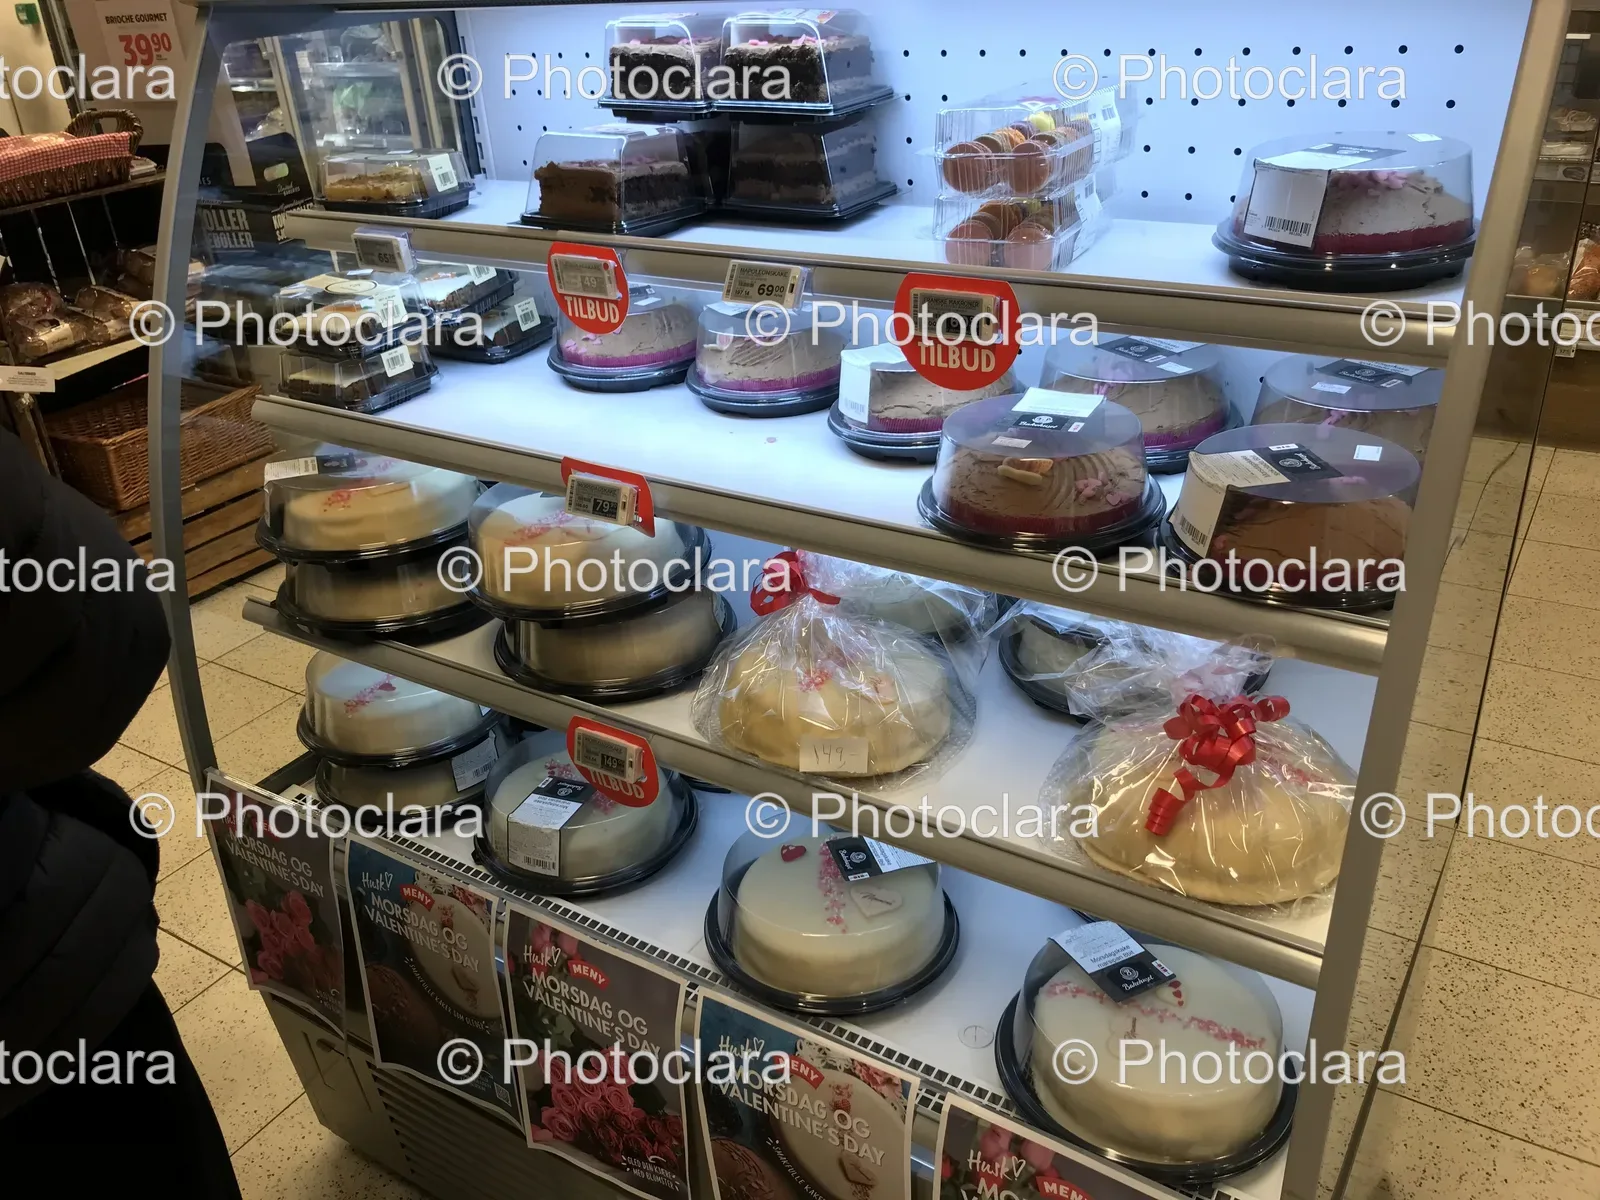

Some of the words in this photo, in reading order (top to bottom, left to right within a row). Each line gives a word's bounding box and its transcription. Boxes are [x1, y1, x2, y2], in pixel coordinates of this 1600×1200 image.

[105, 14, 135, 25] BRIOCHE
[135, 12, 168, 23] GOURMET
[740, 267, 789, 278] NAPOLEONSKAKE
[564, 295, 620, 324] TILBUD
[918, 341, 996, 373] TILBUD
[589, 767, 645, 799] TILBUD
[225, 840, 300, 887] VALENTINE'S
[300, 878, 325, 898] DAY
[290, 856, 313, 878] OG
[402, 887, 431, 906] MENY
[371, 892, 438, 937] MORSDAG
[442, 926, 469, 950] OG
[364, 905, 450, 960] VALENTINE'S
[452, 949, 480, 973] DAY
[572, 963, 605, 985] MENY
[531, 968, 613, 1020] MORSDAG
[617, 1009, 648, 1036] OG
[523, 980, 625, 1044] VALENTINE'S
[627, 1032, 661, 1061] DAY
[779, 1058, 819, 1082] ENY
[716, 1075, 840, 1147] VALENTINE'S
[843, 1135, 886, 1166] DAY
[833, 1109, 871, 1139] OG
[1043, 1181, 1088, 1200] MEN
